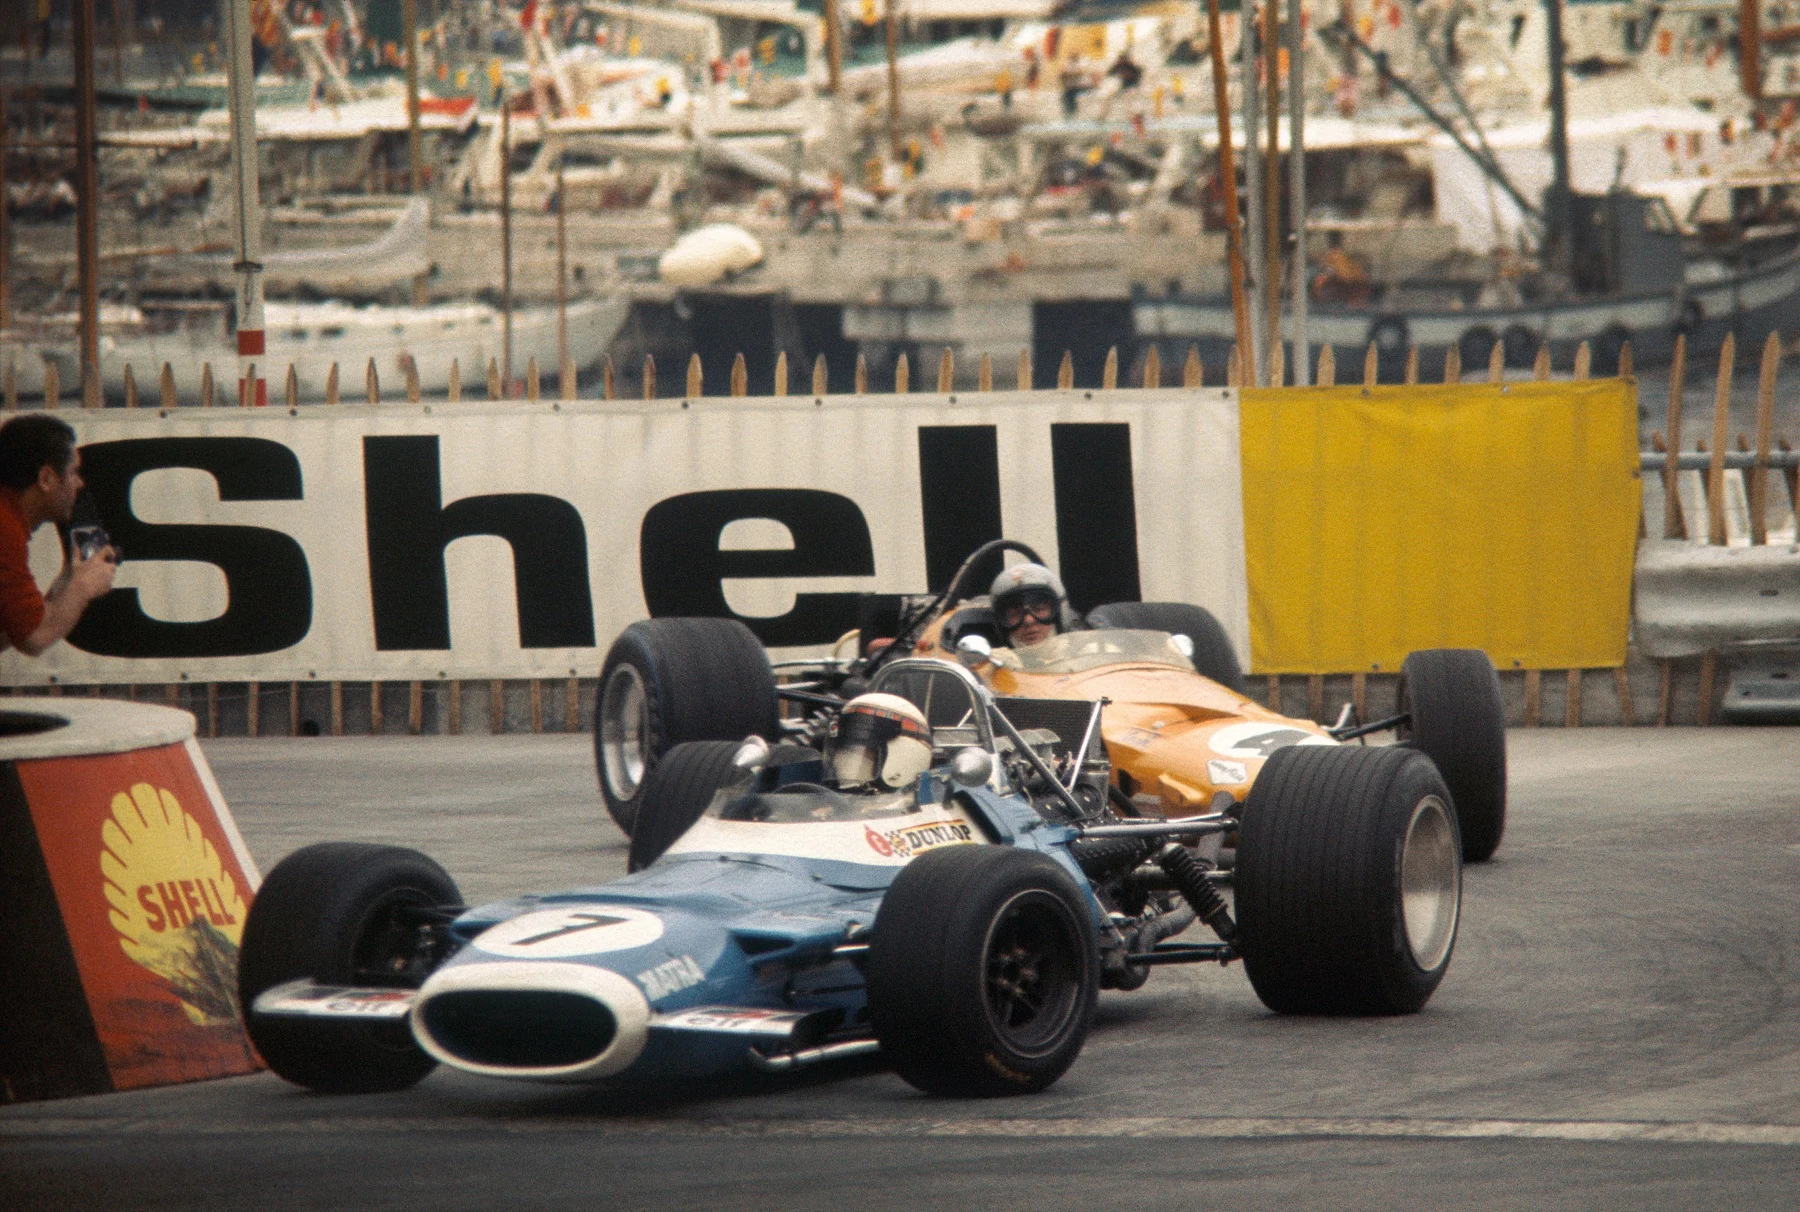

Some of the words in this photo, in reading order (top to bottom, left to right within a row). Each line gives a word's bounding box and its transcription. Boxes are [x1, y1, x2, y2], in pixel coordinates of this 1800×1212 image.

[58, 422, 1142, 659] Shell
[905, 824, 971, 849] DUNLOP
[137, 877, 236, 933] SHELL
[510, 913, 632, 946] 7
